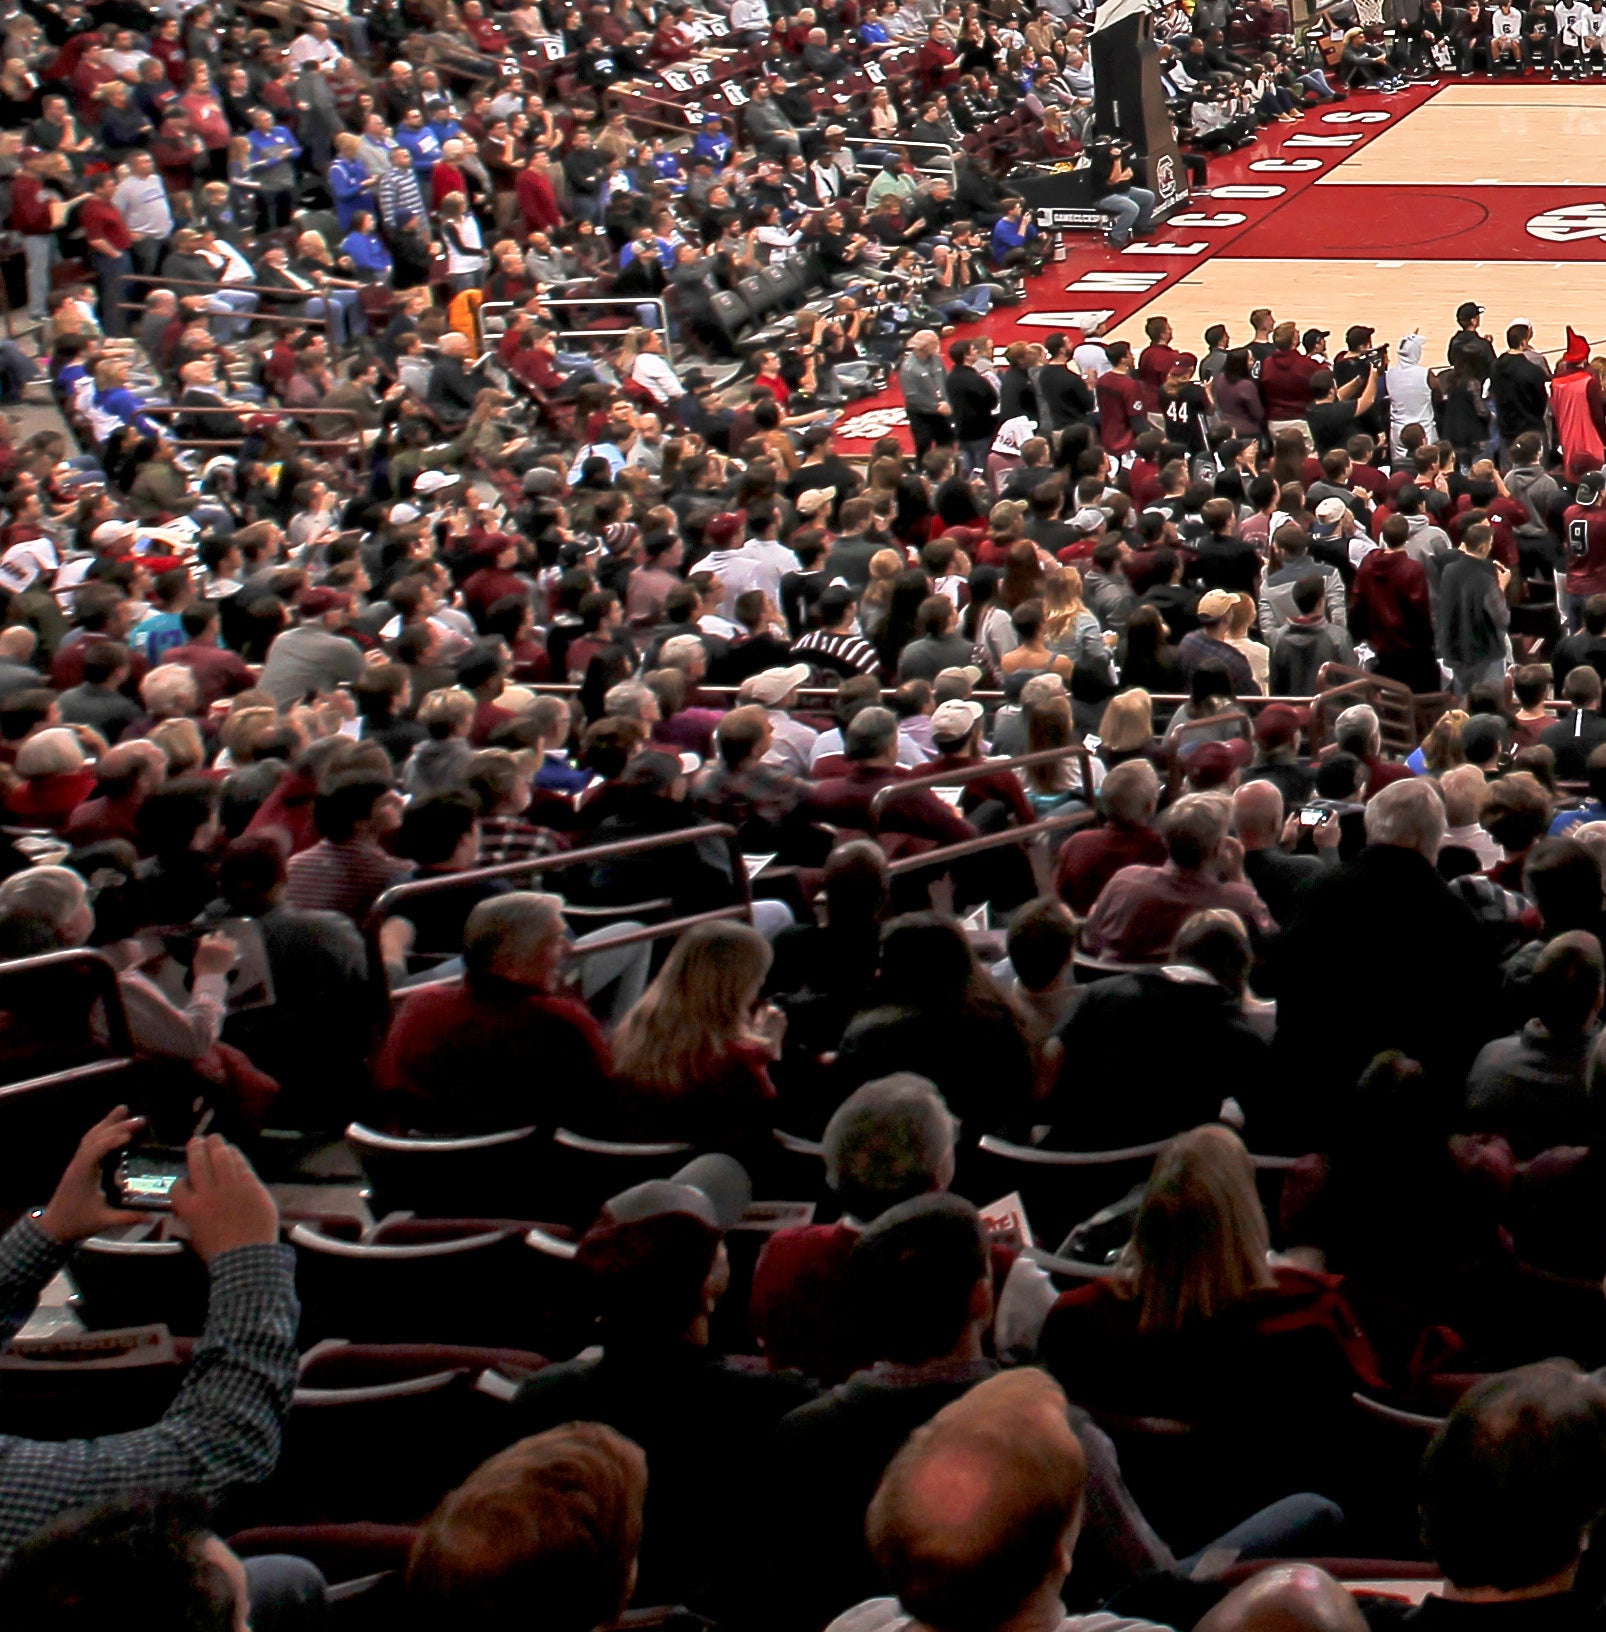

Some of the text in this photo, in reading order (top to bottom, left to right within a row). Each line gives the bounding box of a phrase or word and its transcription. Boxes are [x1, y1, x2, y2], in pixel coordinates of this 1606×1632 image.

[994, 110, 1392, 365] AMECOCKS
[1166, 401, 1189, 424] 44
[1568, 519, 1588, 557] 9
